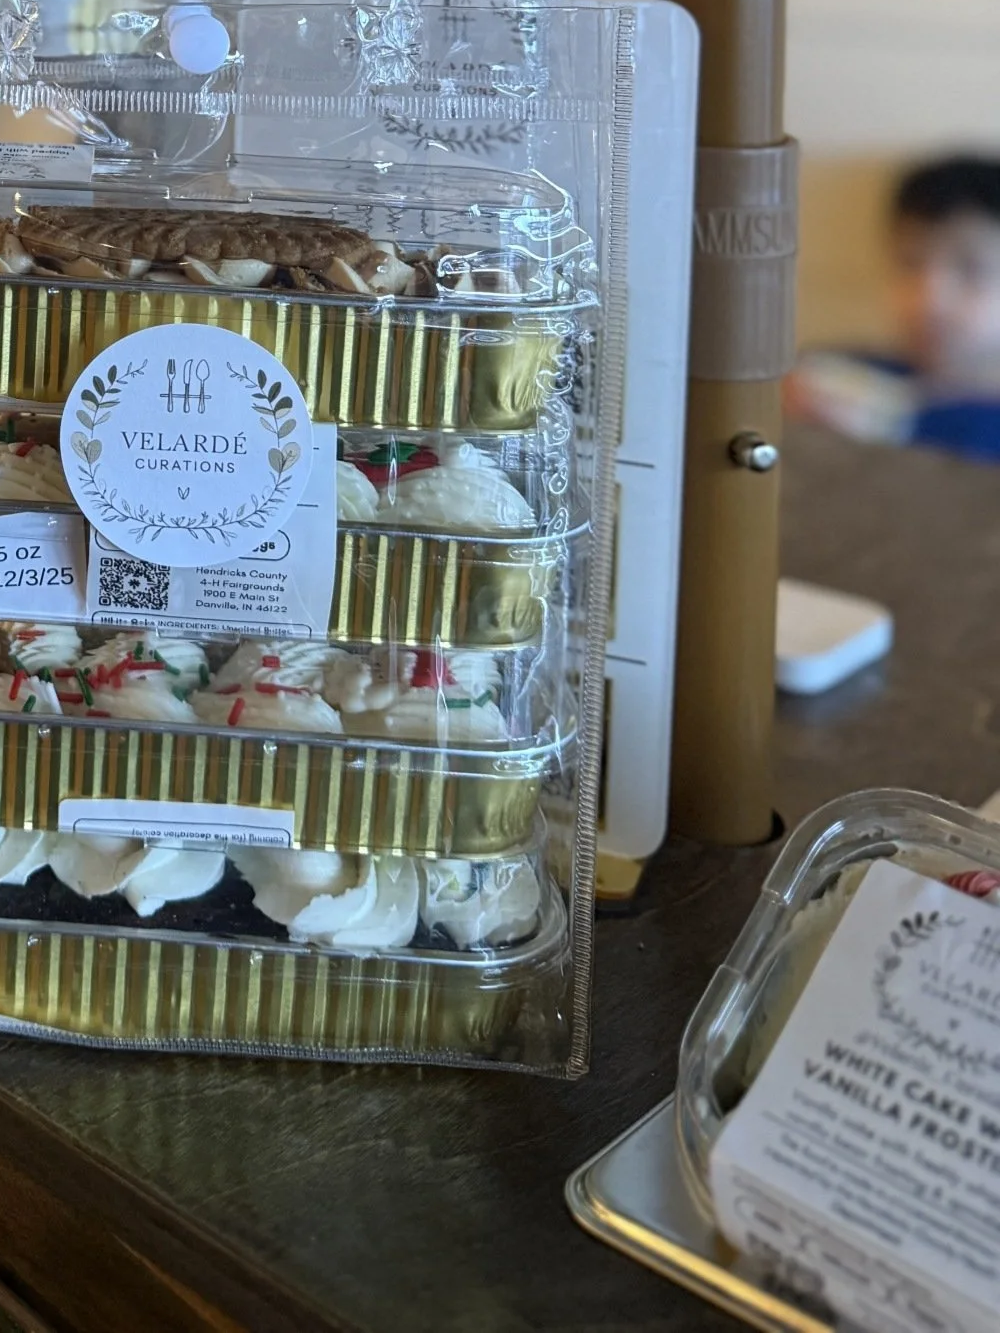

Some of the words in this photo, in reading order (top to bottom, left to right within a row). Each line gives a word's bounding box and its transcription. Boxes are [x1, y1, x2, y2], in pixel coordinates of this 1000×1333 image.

[121, 431, 248, 455] VELARDÉ
[135, 458, 235, 473] CURATIONS
[15, 544, 42, 561] oz
[196, 566, 247, 578] Hendricks
[249, 569, 288, 582] County
[200, 578, 220, 587] 4-H
[222, 579, 285, 592] Fairgrounds
[203, 589, 226, 598] 1900
[229, 591, 237, 599] E
[239, 592, 265, 602] Main
[268, 594, 279, 603] St
[195, 599, 239, 613] Danville,
[242, 603, 252, 611] IN
[256, 605, 288, 613] 46122
[157, 620, 220, 631] INGREDIENTS:
[825, 1039, 898, 1090] WHITE
[904, 1079, 972, 1124] CAKE
[804, 1058, 902, 1123] VANILLA
